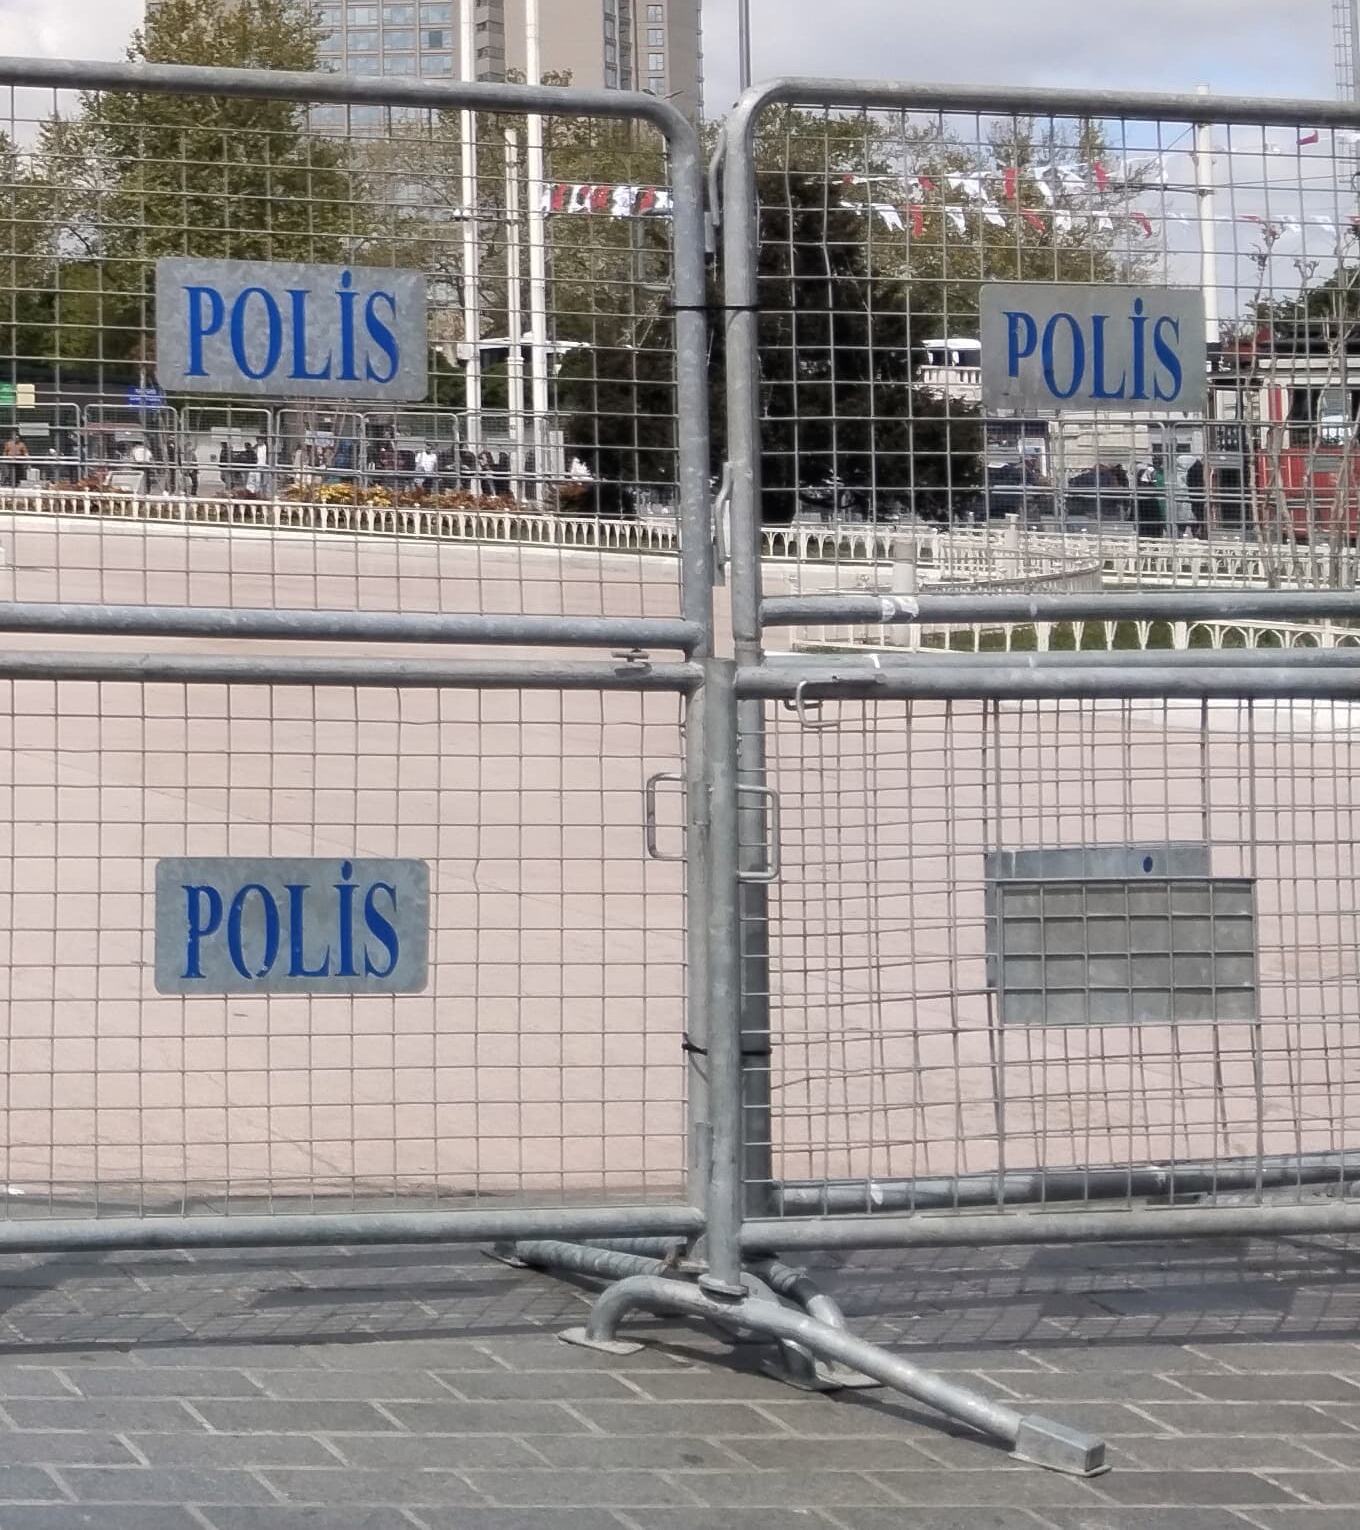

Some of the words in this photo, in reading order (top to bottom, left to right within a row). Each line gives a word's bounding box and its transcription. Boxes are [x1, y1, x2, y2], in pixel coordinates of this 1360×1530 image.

[183, 269, 400, 384] POLİS
[1002, 297, 1183, 401] POLİS
[180, 860, 400, 980] POLİS
